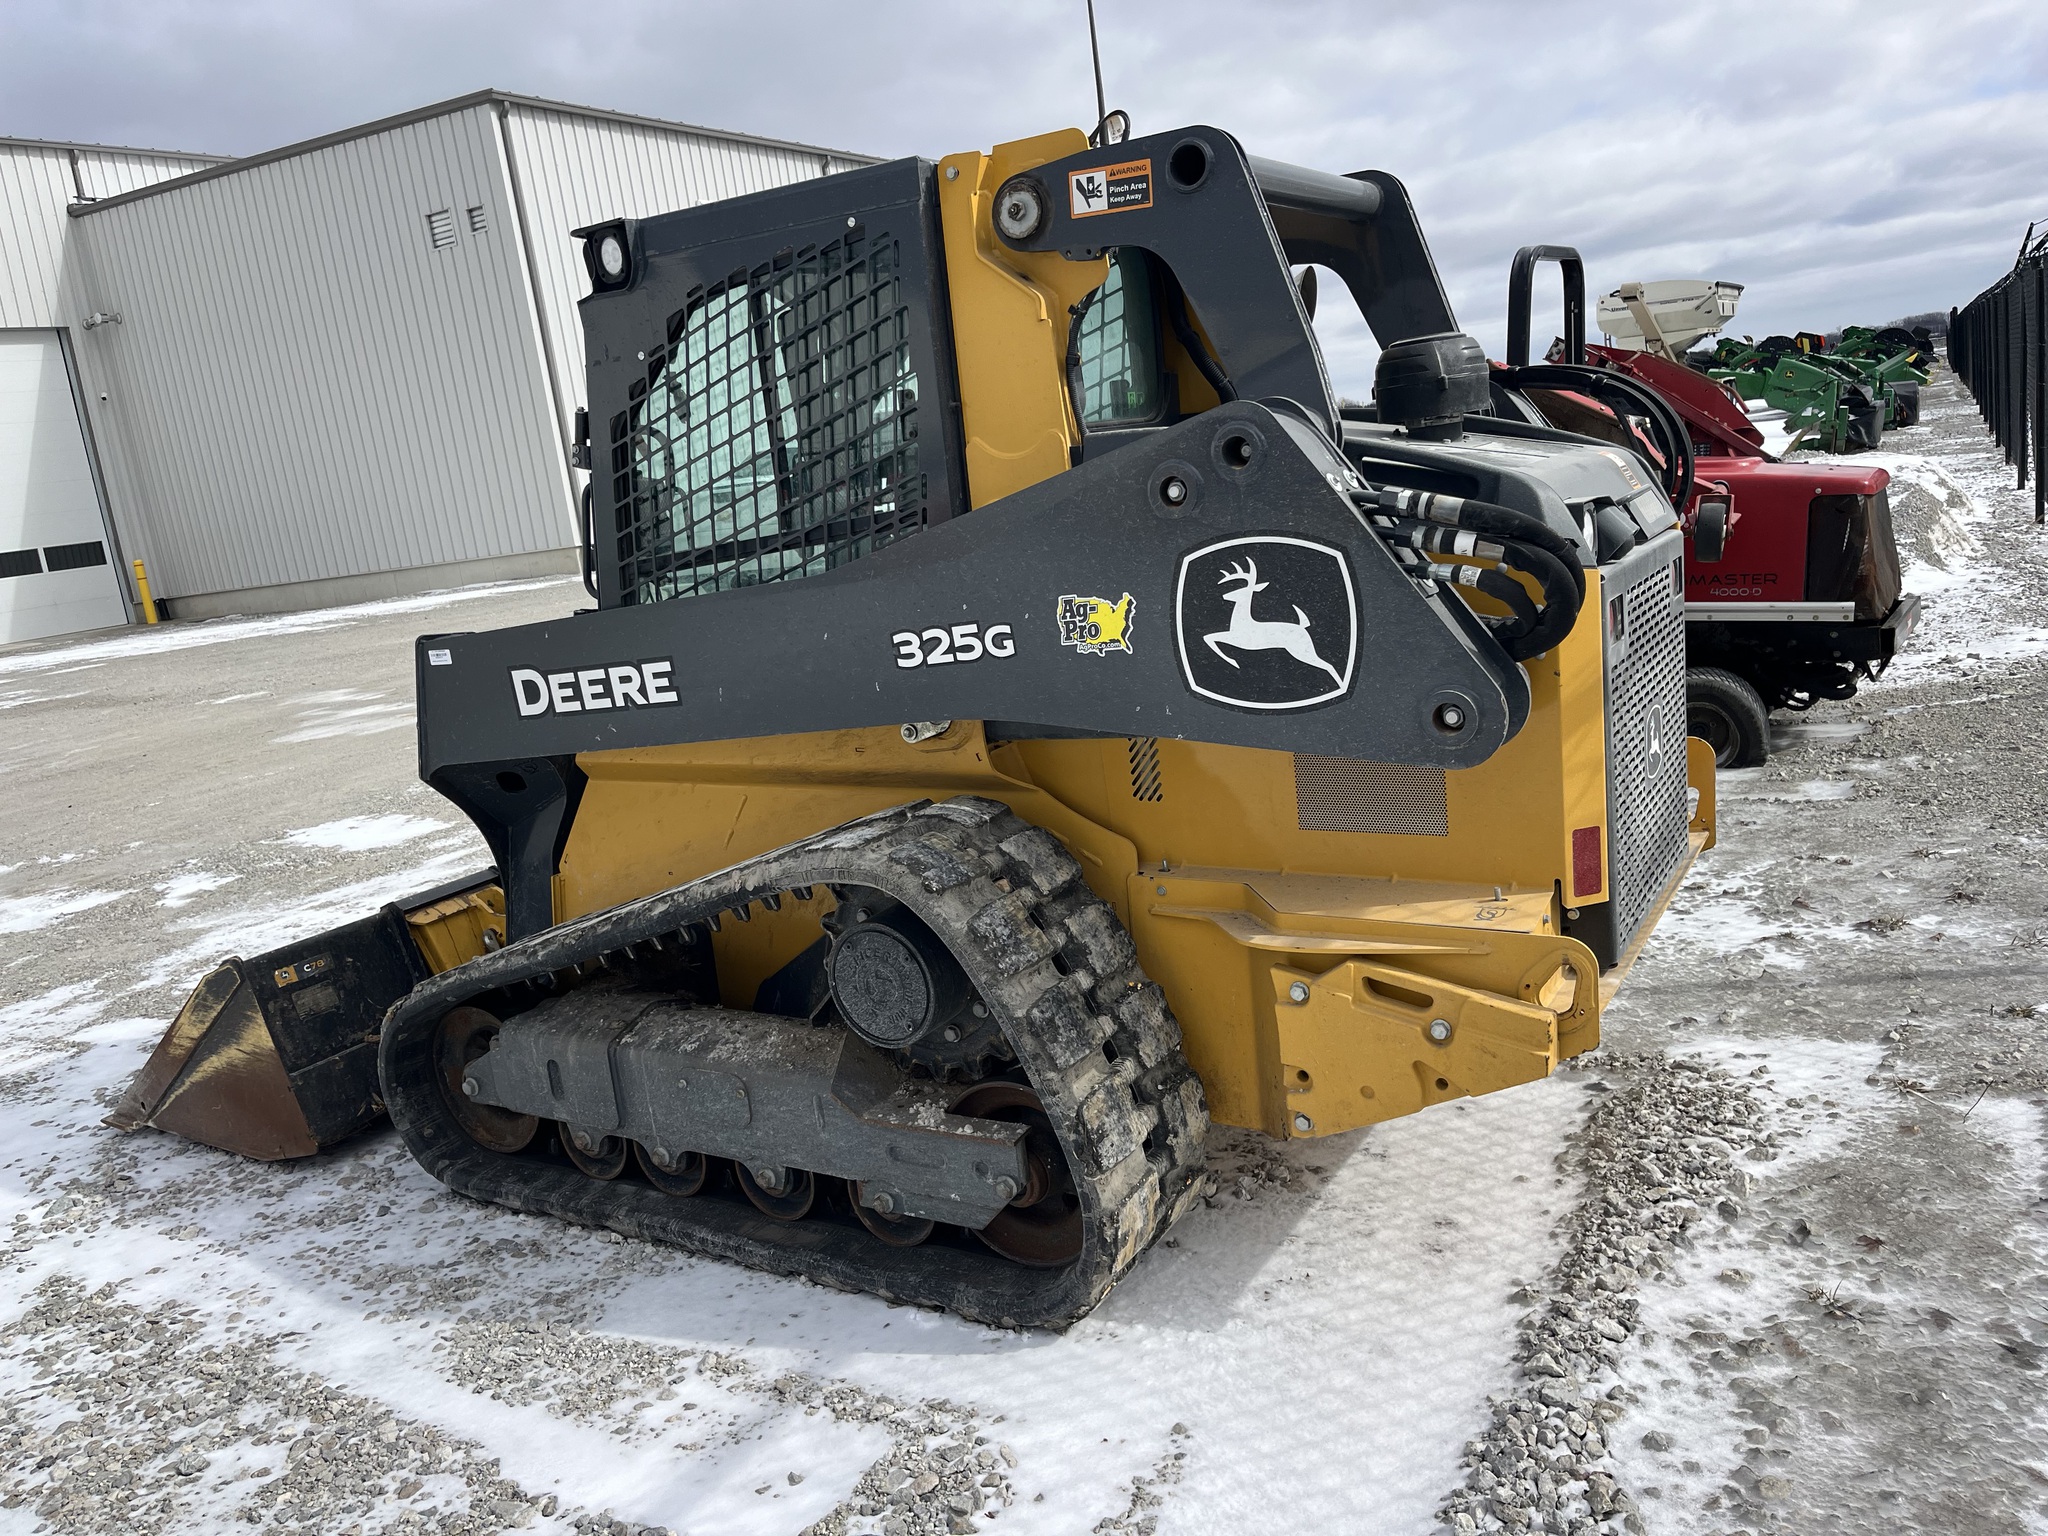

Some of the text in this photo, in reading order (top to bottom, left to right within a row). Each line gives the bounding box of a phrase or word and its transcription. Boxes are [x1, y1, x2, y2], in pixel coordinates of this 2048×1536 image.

[1115, 164, 1147, 176] WARNING
[1109, 182, 1147, 194] Pinch Area
[1109, 193, 1142, 203] Keep Away
[1685, 573, 1778, 586] MASTER
[1063, 620, 1101, 641] Pro
[892, 623, 1016, 668] 325G
[1079, 642, 1122, 652] AgProCo.com
[510, 660, 679, 717] DEERE
